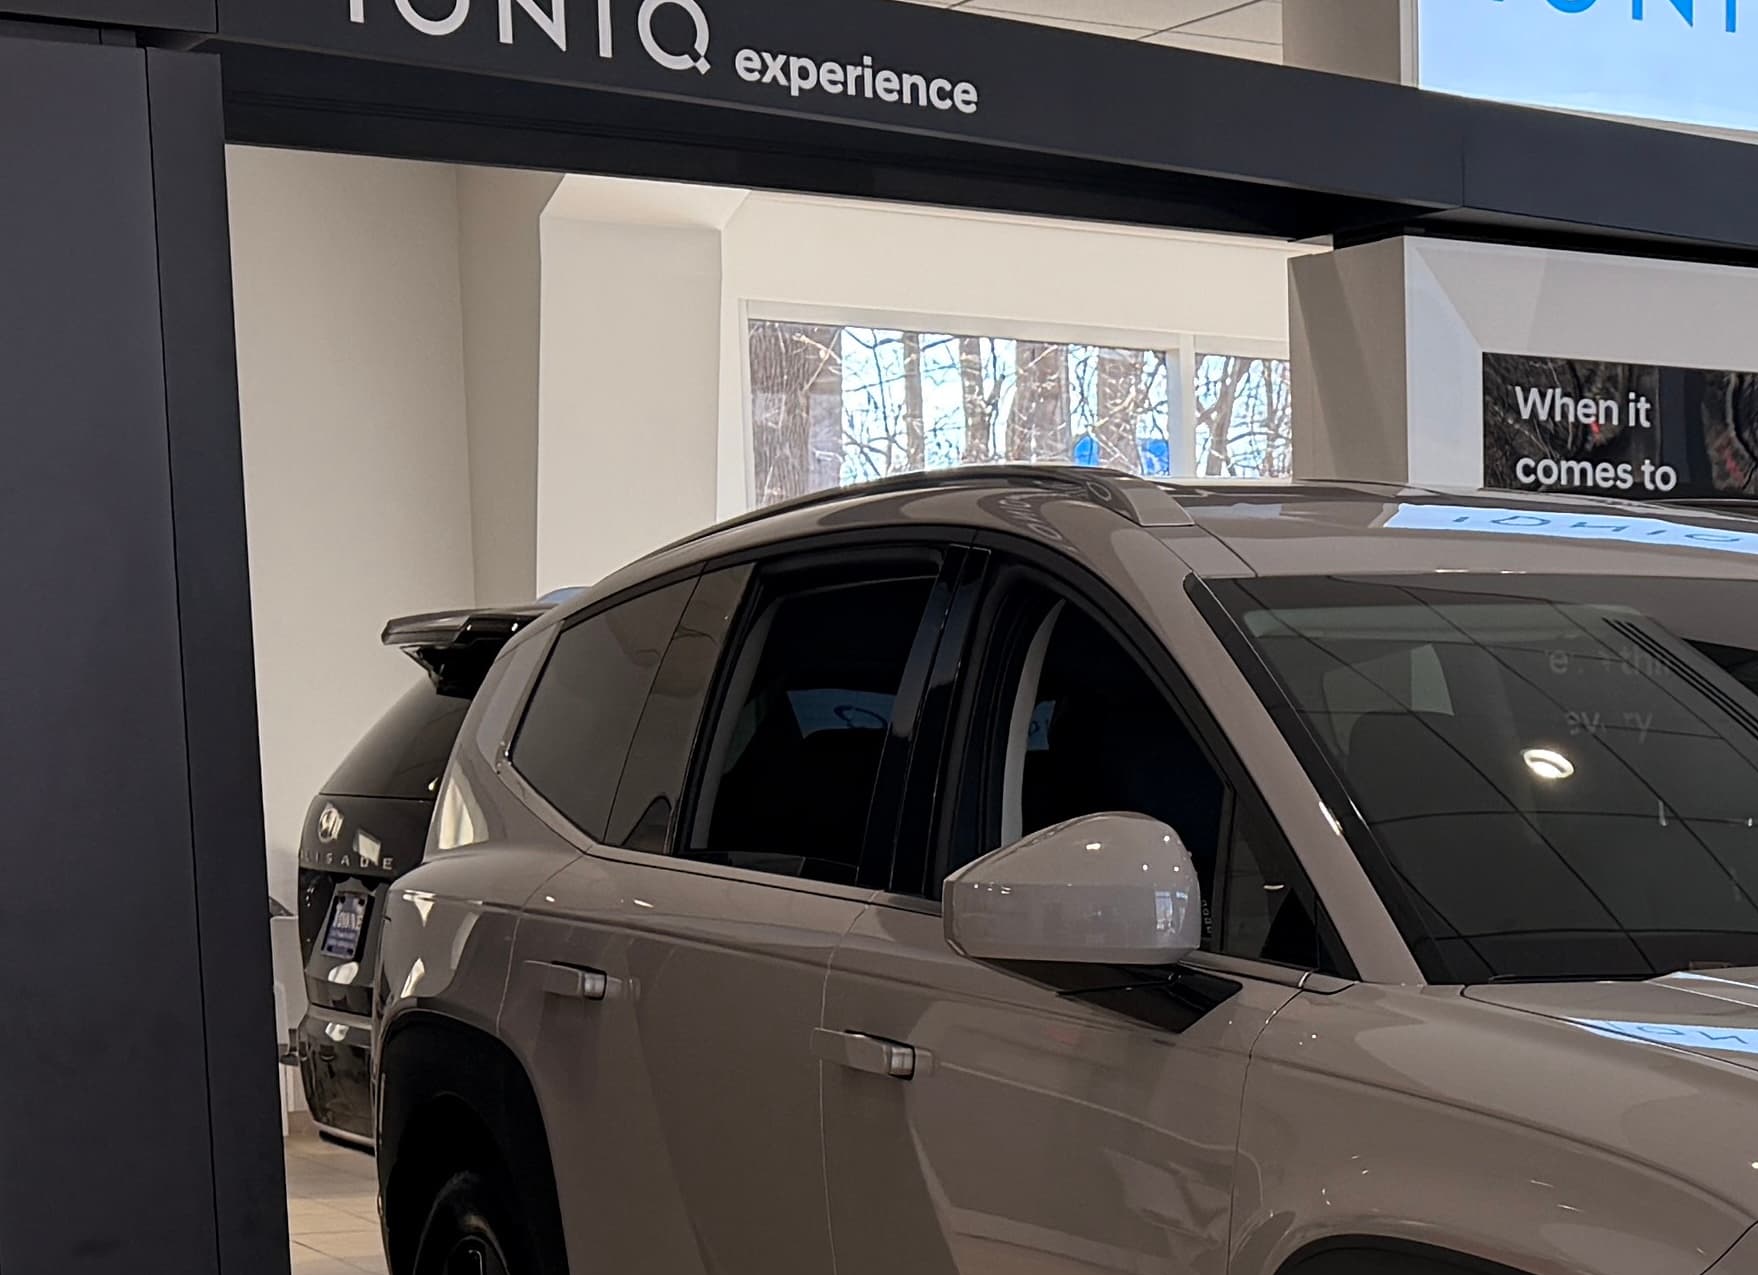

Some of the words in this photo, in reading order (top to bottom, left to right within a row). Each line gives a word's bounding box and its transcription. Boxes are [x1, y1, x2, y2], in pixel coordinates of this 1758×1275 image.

[735, 48, 978, 114] experience
[1515, 385, 1619, 425] When
[1628, 392, 1651, 428] it
[1515, 457, 1634, 491] comes
[1641, 458, 1677, 492] to
